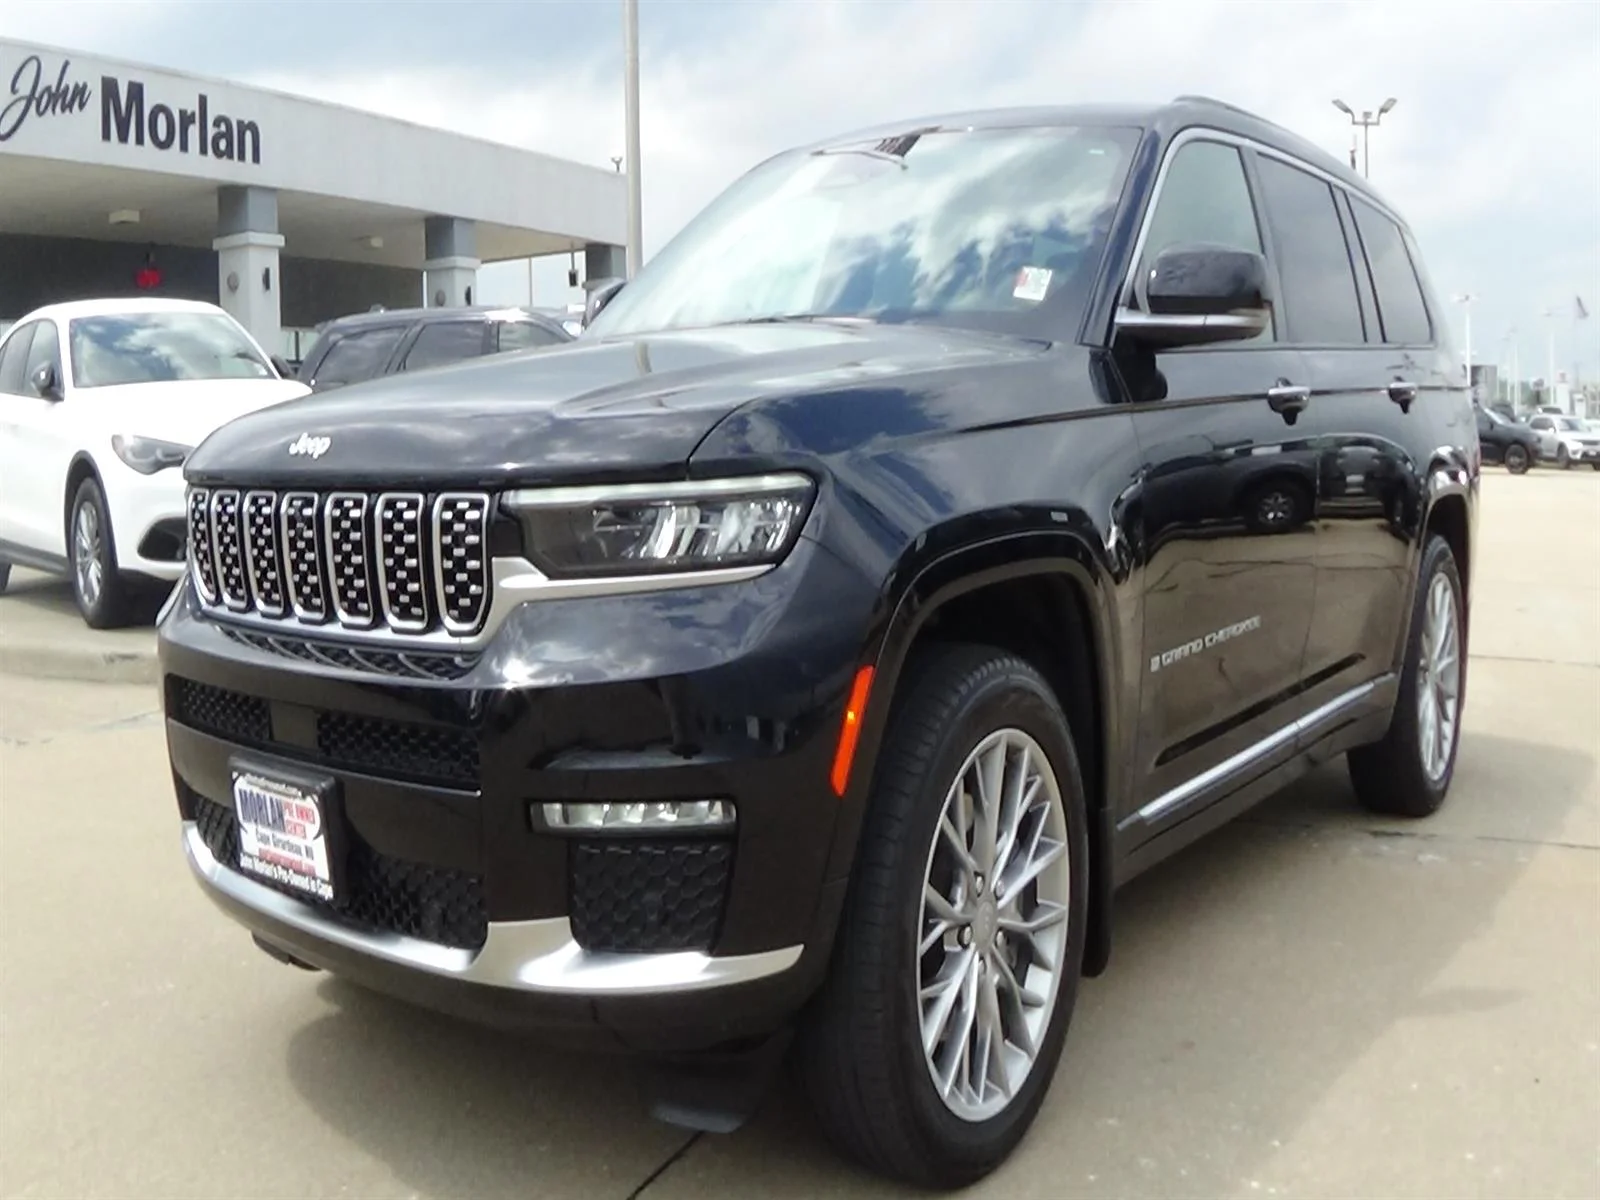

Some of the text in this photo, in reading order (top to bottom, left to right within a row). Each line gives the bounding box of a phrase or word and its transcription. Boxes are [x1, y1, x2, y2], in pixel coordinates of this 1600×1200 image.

[0, 55, 261, 164] John Morlan
[289, 432, 331, 459] Jeep
[1161, 638, 1203, 666] GRAND
[238, 788, 286, 833] MORLAN
